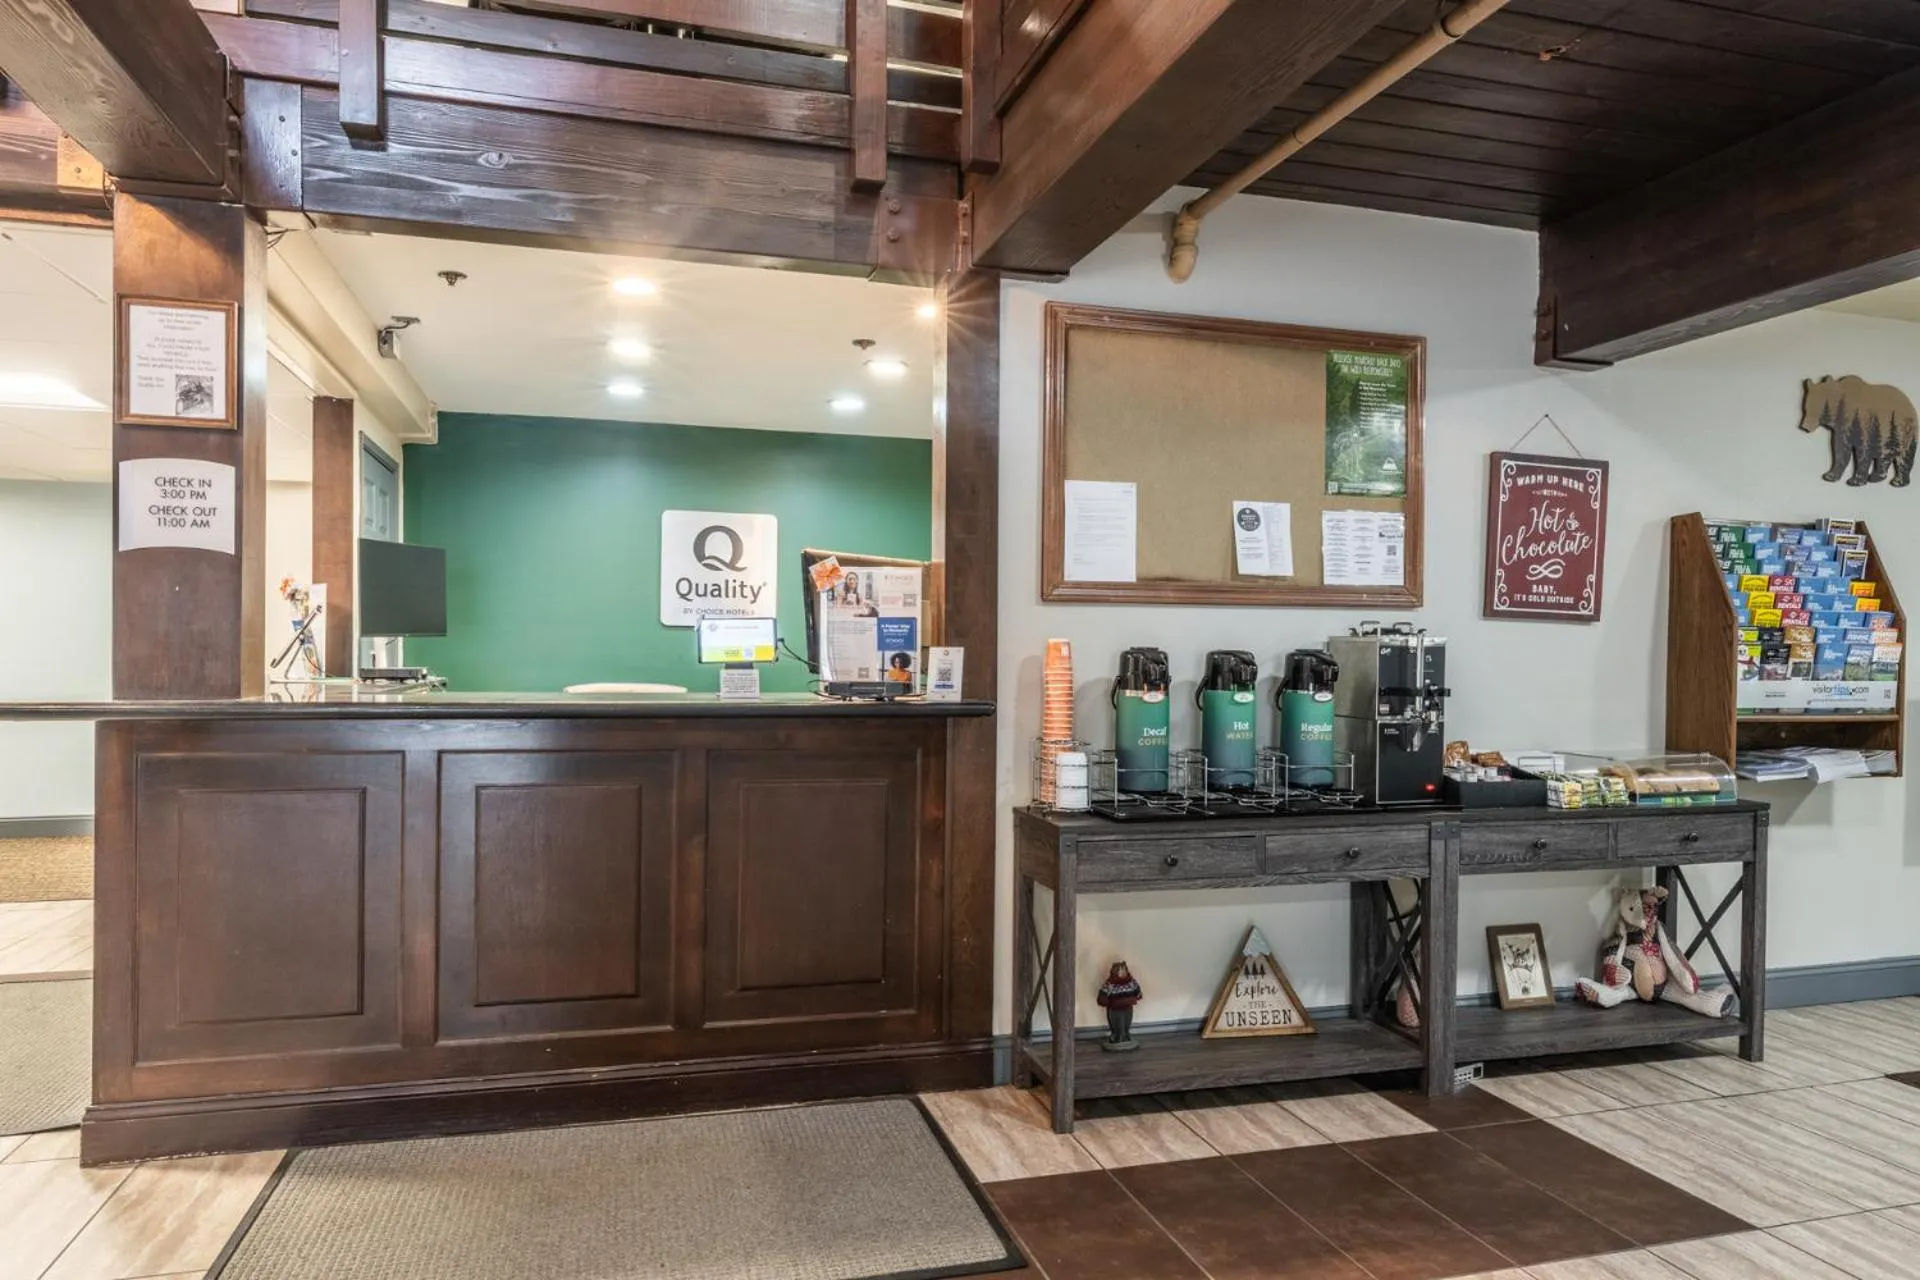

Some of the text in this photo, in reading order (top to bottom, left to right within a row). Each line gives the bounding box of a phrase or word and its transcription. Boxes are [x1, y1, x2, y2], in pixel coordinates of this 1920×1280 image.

[154, 477, 212, 489] CHECK IN
[1516, 474, 1585, 493] WARM UP HERE
[160, 489, 207, 501] 3:00 PM
[148, 504, 218, 517] CHECK OUT
[157, 517, 210, 528] 11:00 AM
[1526, 500, 1566, 537] Hot
[1502, 526, 1592, 565] Chocolate
[676, 577, 762, 604] Quality
[1528, 594, 1546, 603] COLD
[1547, 595, 1574, 604] OUTSIDE
[695, 607, 723, 615] CHOICE
[726, 608, 755, 616] HOTELS
[1143, 726, 1167, 736] Decaf
[1232, 720, 1249, 730] Hot
[1235, 981, 1278, 1000] Explore
[1248, 1000, 1267, 1009] THE
[1224, 1009, 1292, 1027] UNSEEN
